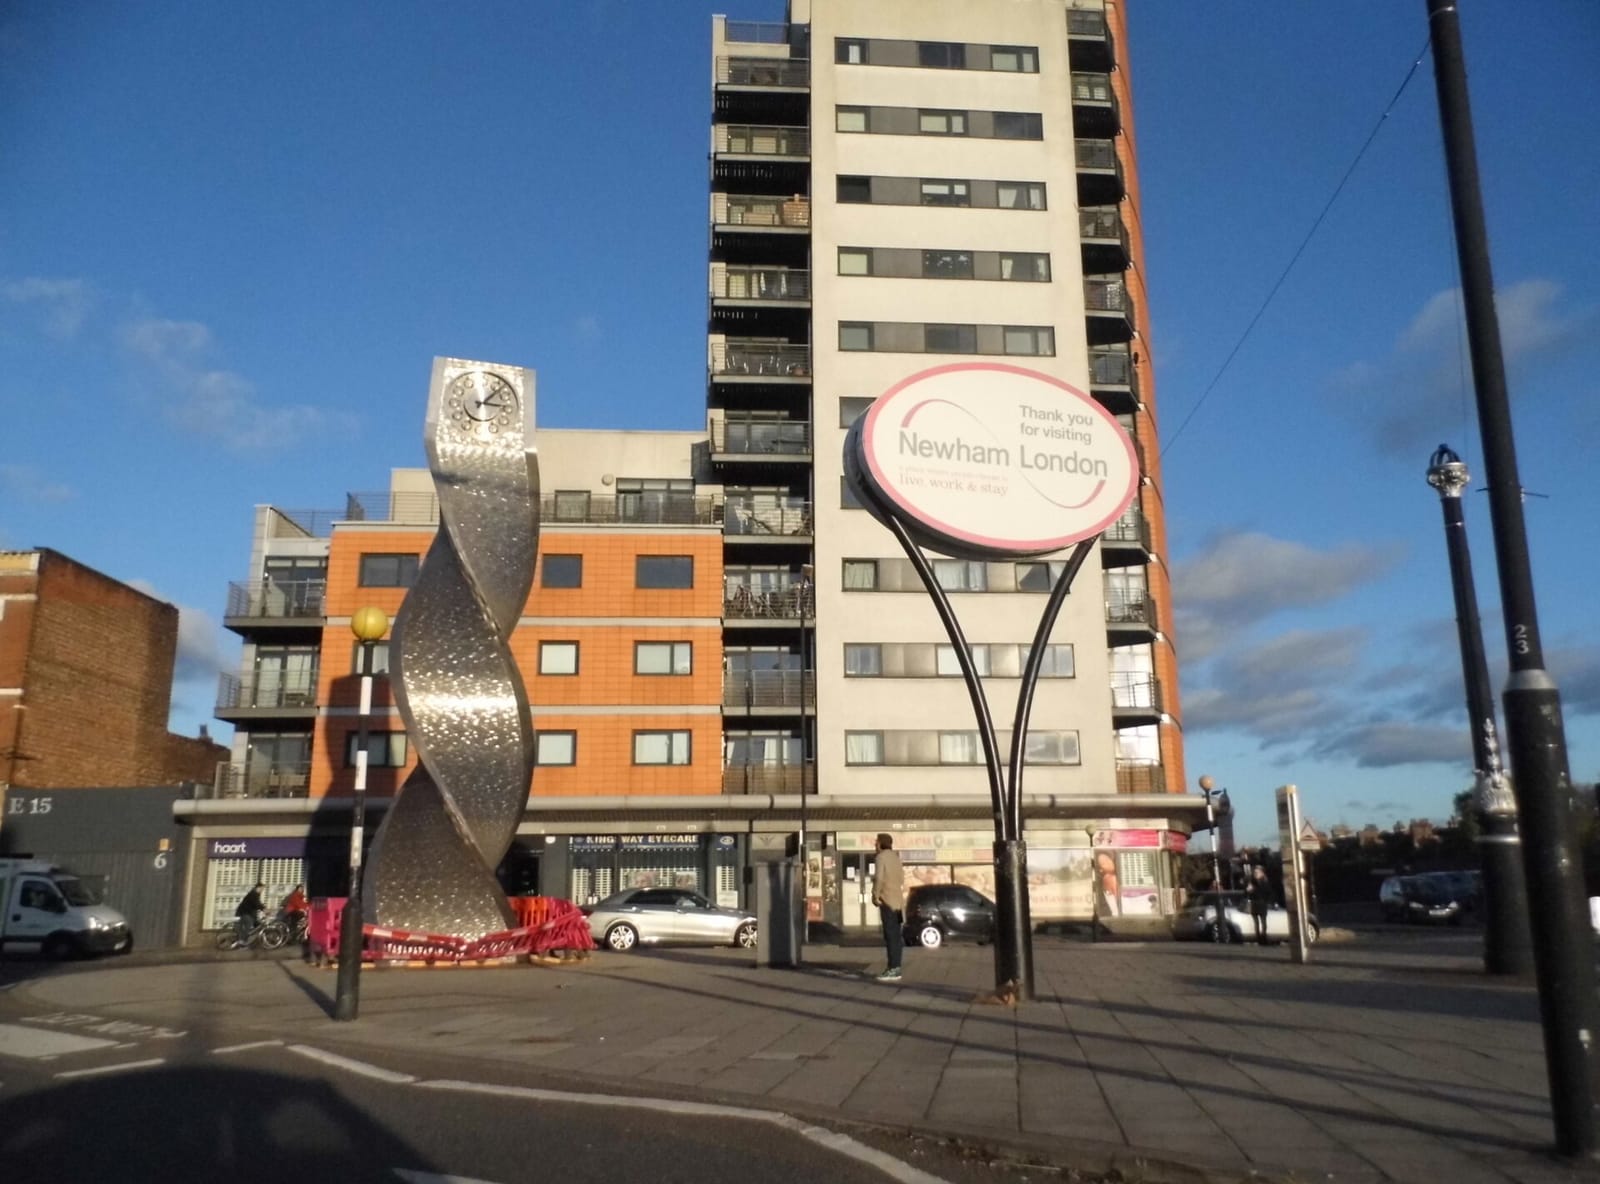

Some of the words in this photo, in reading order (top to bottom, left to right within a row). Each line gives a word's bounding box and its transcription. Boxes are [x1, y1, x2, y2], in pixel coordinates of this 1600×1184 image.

[1019, 404, 1064, 423] Thank
[1067, 413, 1094, 427] you
[1020, 421, 1039, 437] for
[1042, 427, 1092, 445] visiting
[898, 431, 1010, 467] Newham
[1019, 444, 1109, 477] London
[929, 478, 964, 492] work
[967, 483, 977, 492] &
[980, 483, 1008, 497] stay
[8, 797, 25, 814] E
[29, 797, 53, 814] 15
[214, 841, 247, 854] haart
[586, 835, 615, 844] KING
[621, 835, 644, 844] WAY
[648, 835, 698, 844] EYECARE
[154, 854, 168, 869] 6
